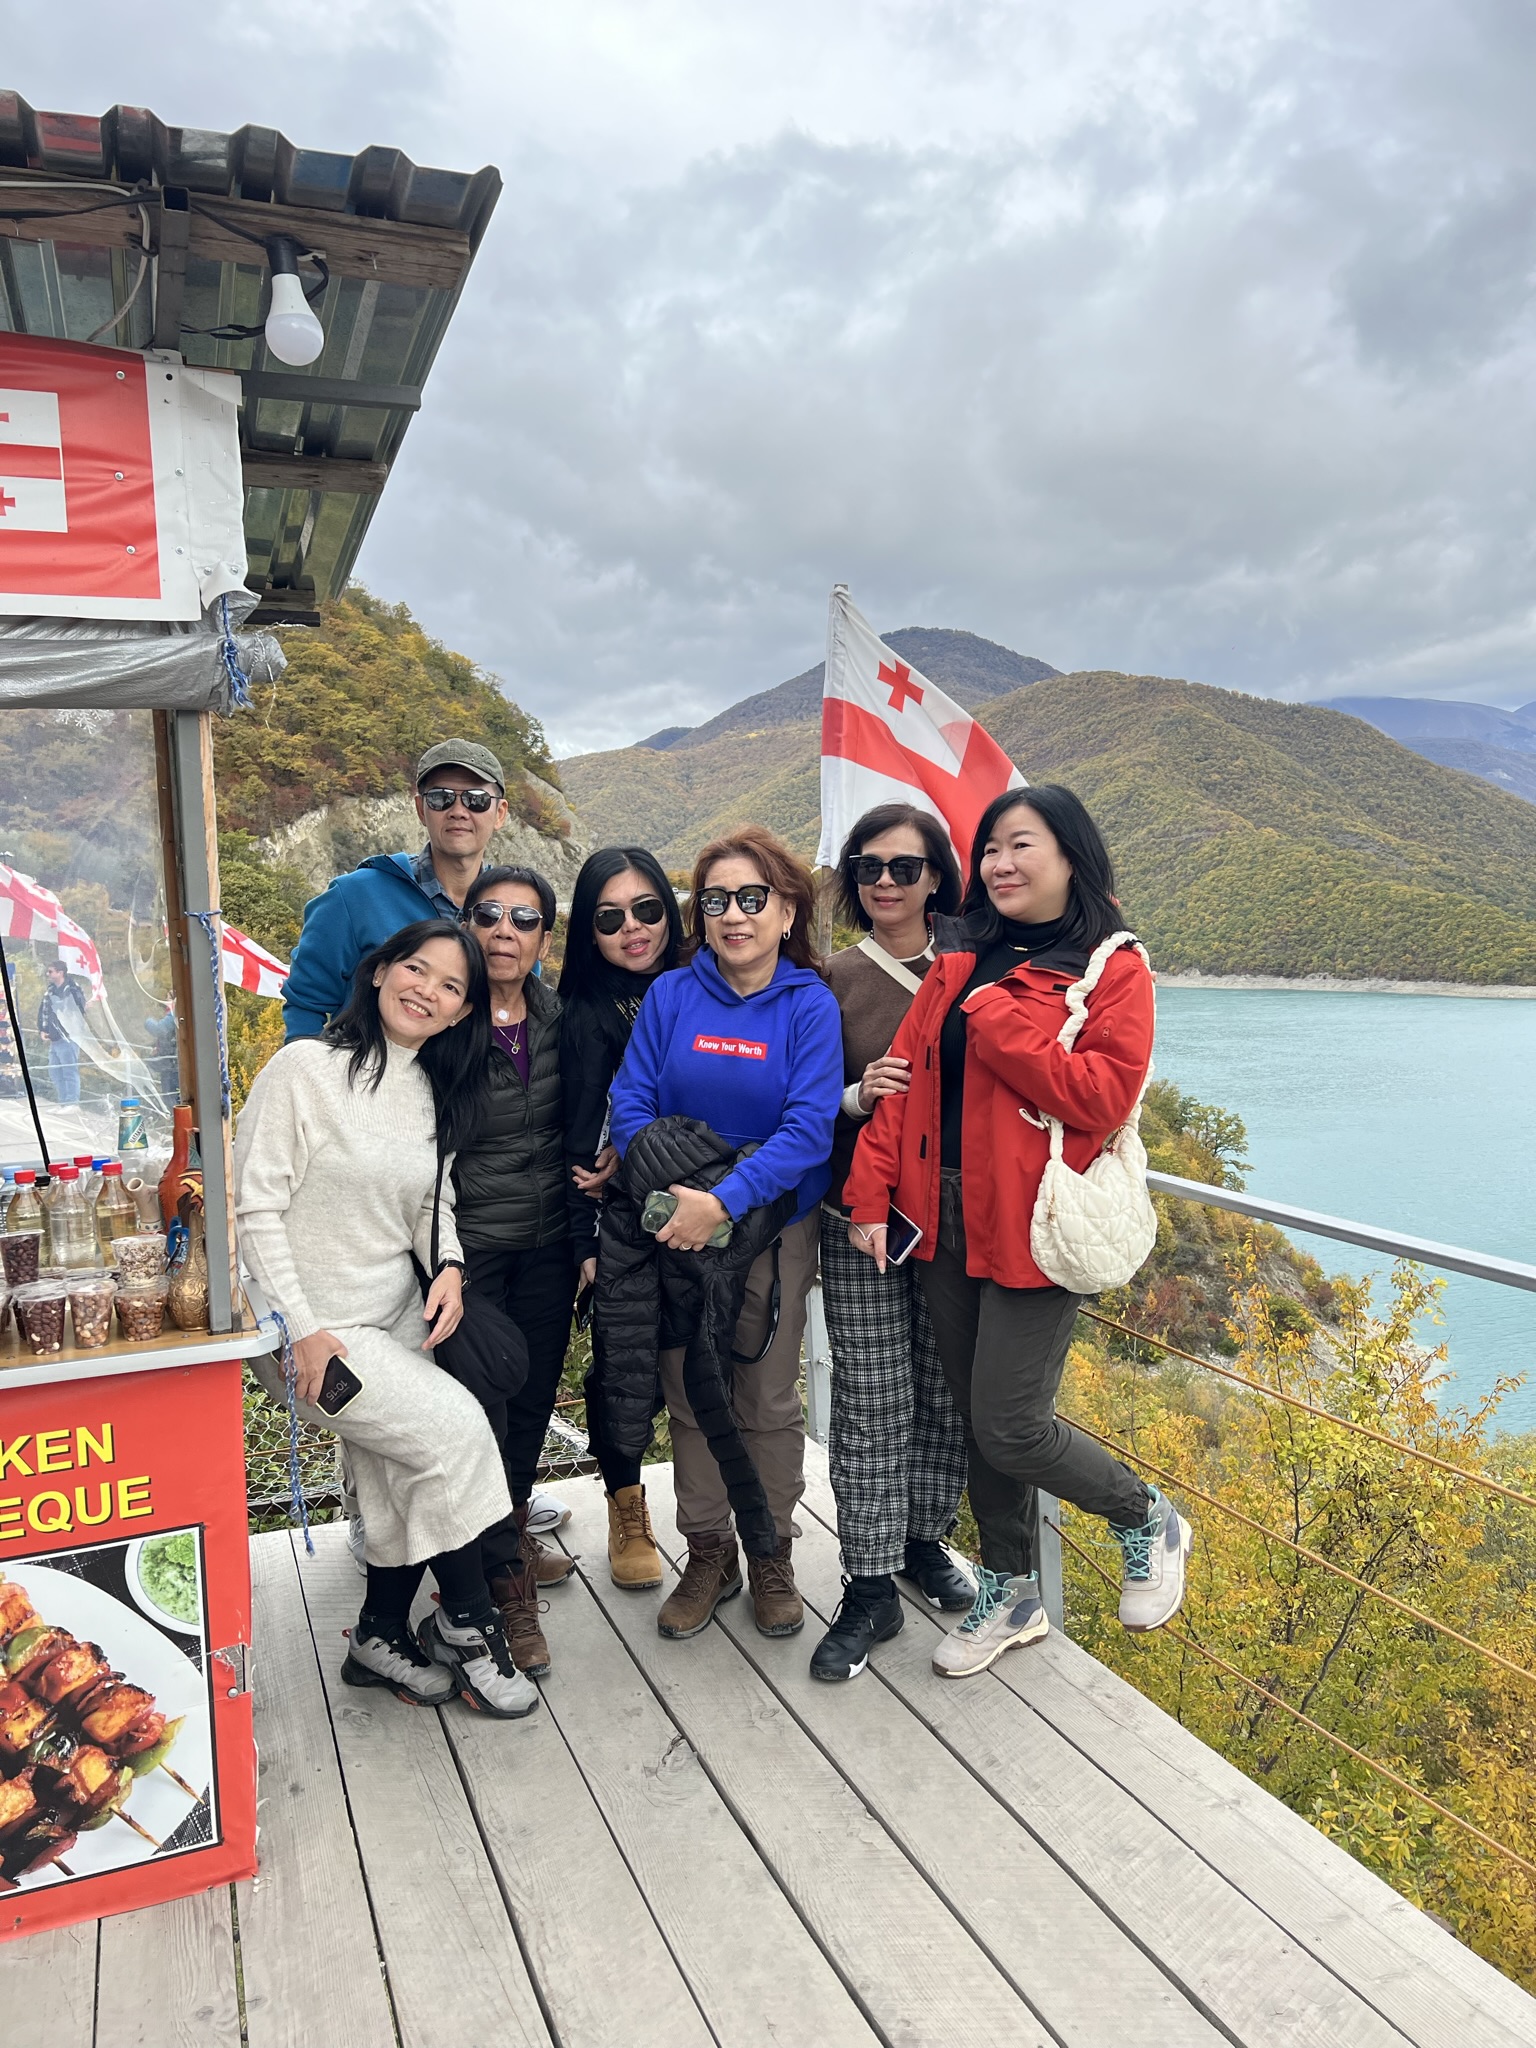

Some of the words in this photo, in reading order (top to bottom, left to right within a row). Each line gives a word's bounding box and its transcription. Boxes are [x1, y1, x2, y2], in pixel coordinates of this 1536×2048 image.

[698, 1039, 720, 1050] Know
[721, 1041, 736, 1052] Your
[738, 1043, 762, 1056] Worth
[326, 1380, 347, 1401] 10:15
[0, 1422, 115, 1480] KEN
[0, 1475, 153, 1539] EQUE
